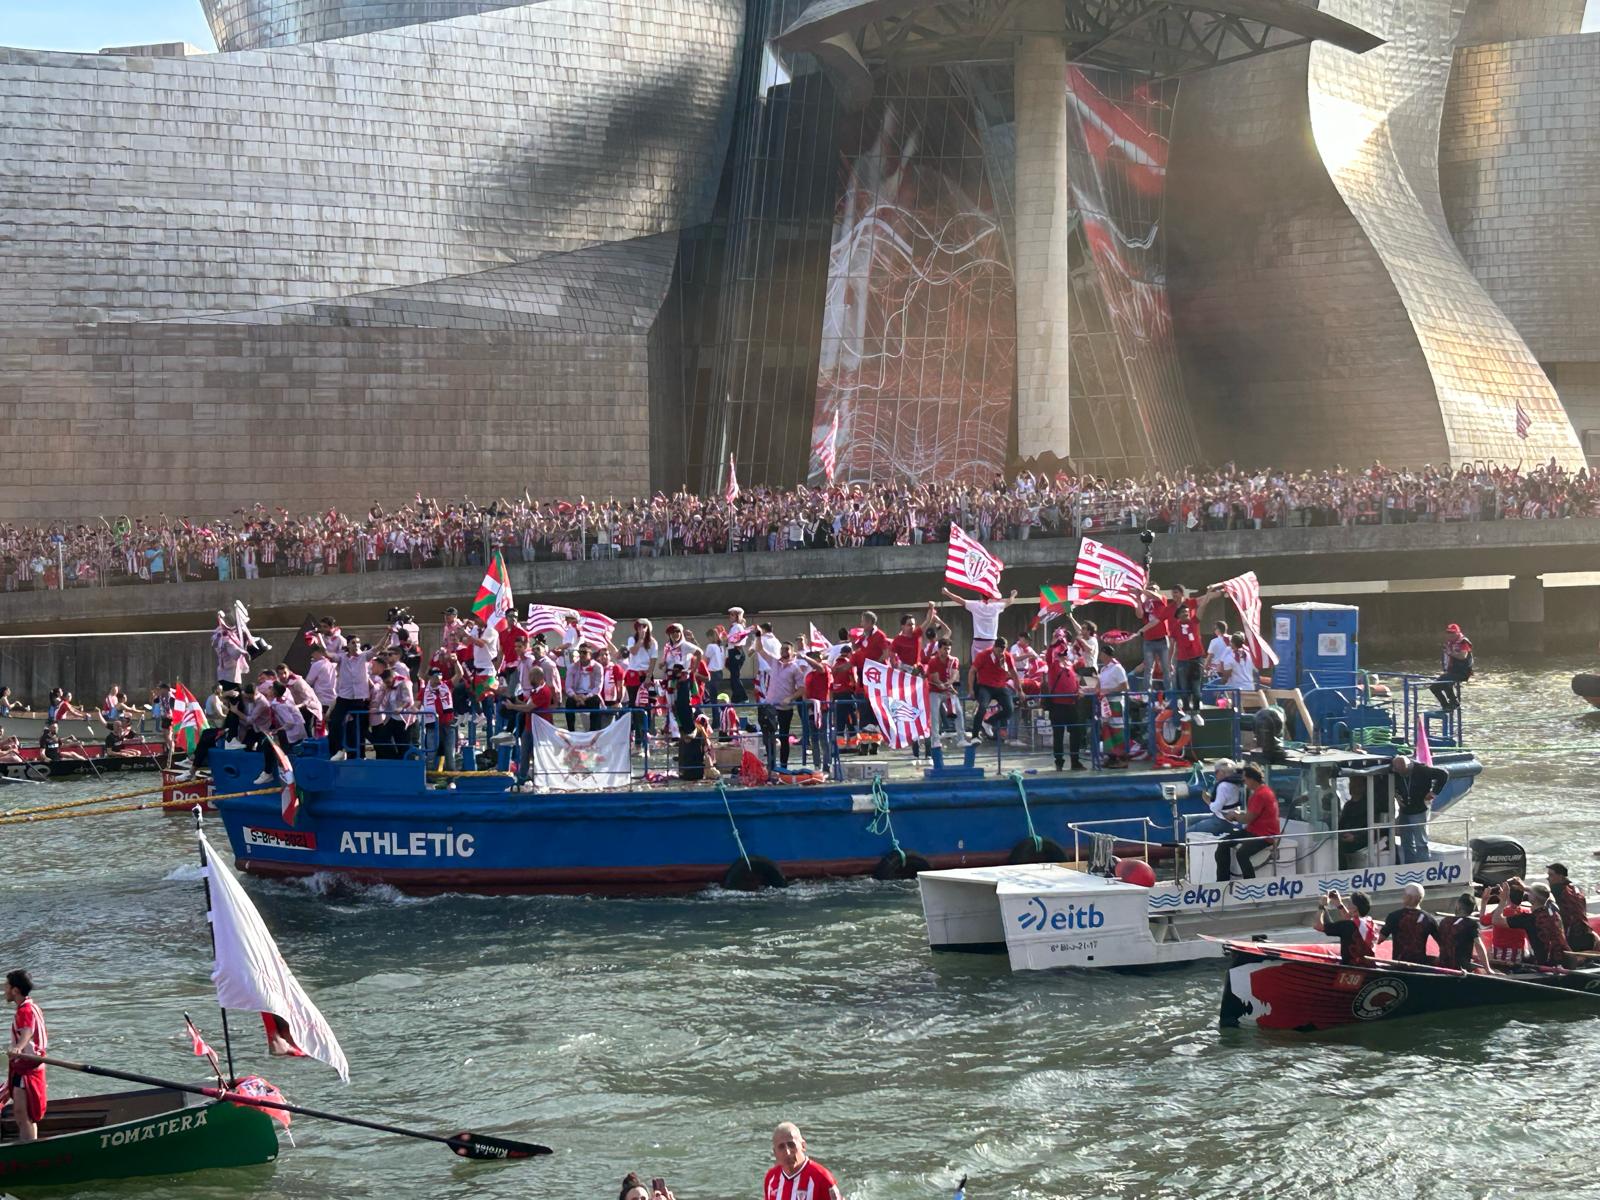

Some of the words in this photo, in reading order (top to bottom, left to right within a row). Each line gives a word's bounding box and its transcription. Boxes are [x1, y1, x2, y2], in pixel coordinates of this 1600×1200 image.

[1184, 885, 1221, 907] ekp
[1267, 877, 1304, 898] ekp
[1351, 869, 1386, 891] ekp
[1426, 862, 1461, 883] ekp
[1050, 903, 1105, 930] eitb
[100, 1109, 209, 1149] TOMATERA
